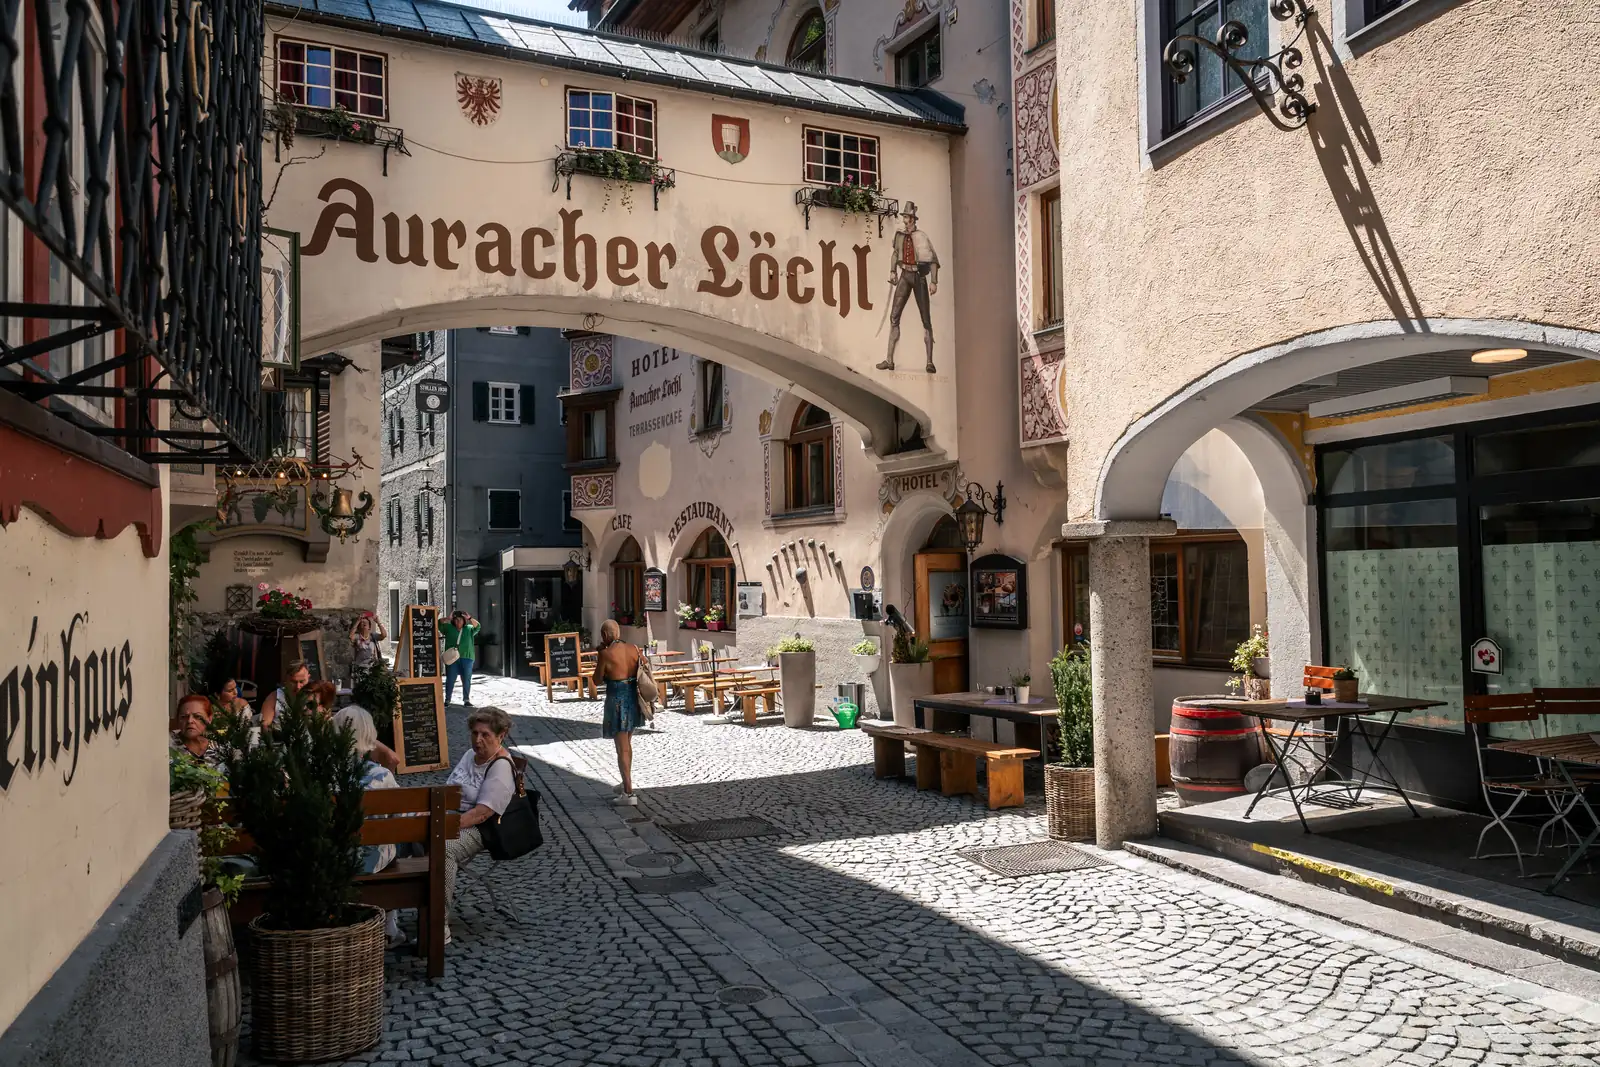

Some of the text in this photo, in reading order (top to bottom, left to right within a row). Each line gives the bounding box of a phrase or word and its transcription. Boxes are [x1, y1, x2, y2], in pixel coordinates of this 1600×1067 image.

[300, 178, 873, 318] Auracher Löchl
[632, 346, 680, 377] HOTEL
[630, 373, 682, 413] Auracher Löchl
[902, 473, 939, 491] HOTEL
[668, 501, 735, 546] RESTAURANT
